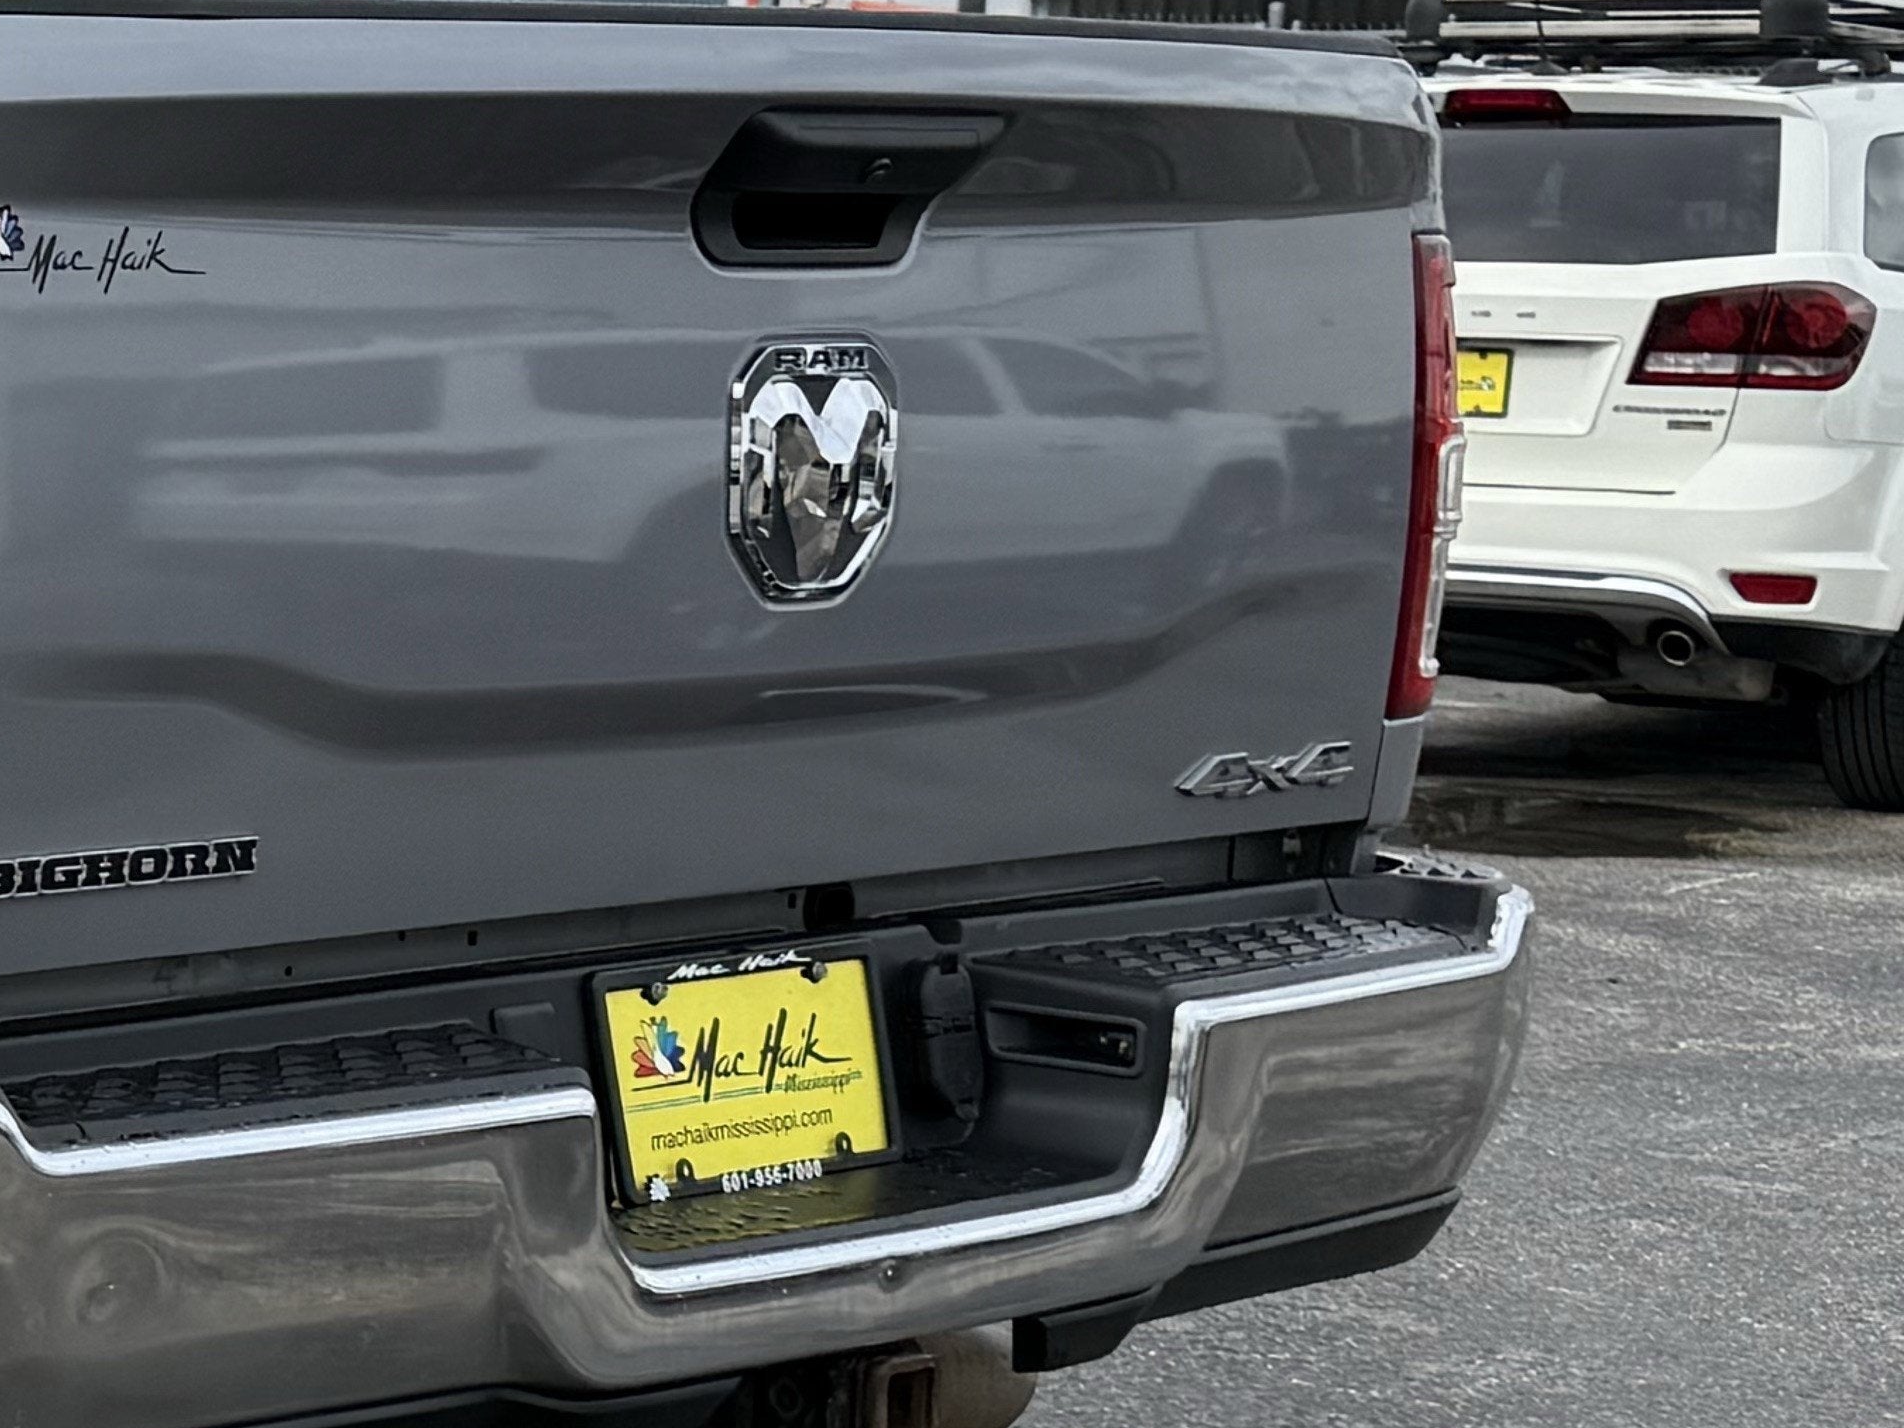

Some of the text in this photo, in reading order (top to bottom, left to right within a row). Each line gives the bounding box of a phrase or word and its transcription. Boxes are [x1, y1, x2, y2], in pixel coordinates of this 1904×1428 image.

[2, 225, 194, 295] Mac Haik
[773, 348, 869, 372] RAM
[666, 949, 812, 981] Mac Haik
[654, 1008, 847, 1103] Mac Haik
[650, 1108, 833, 1151] machaikmississippi.com
